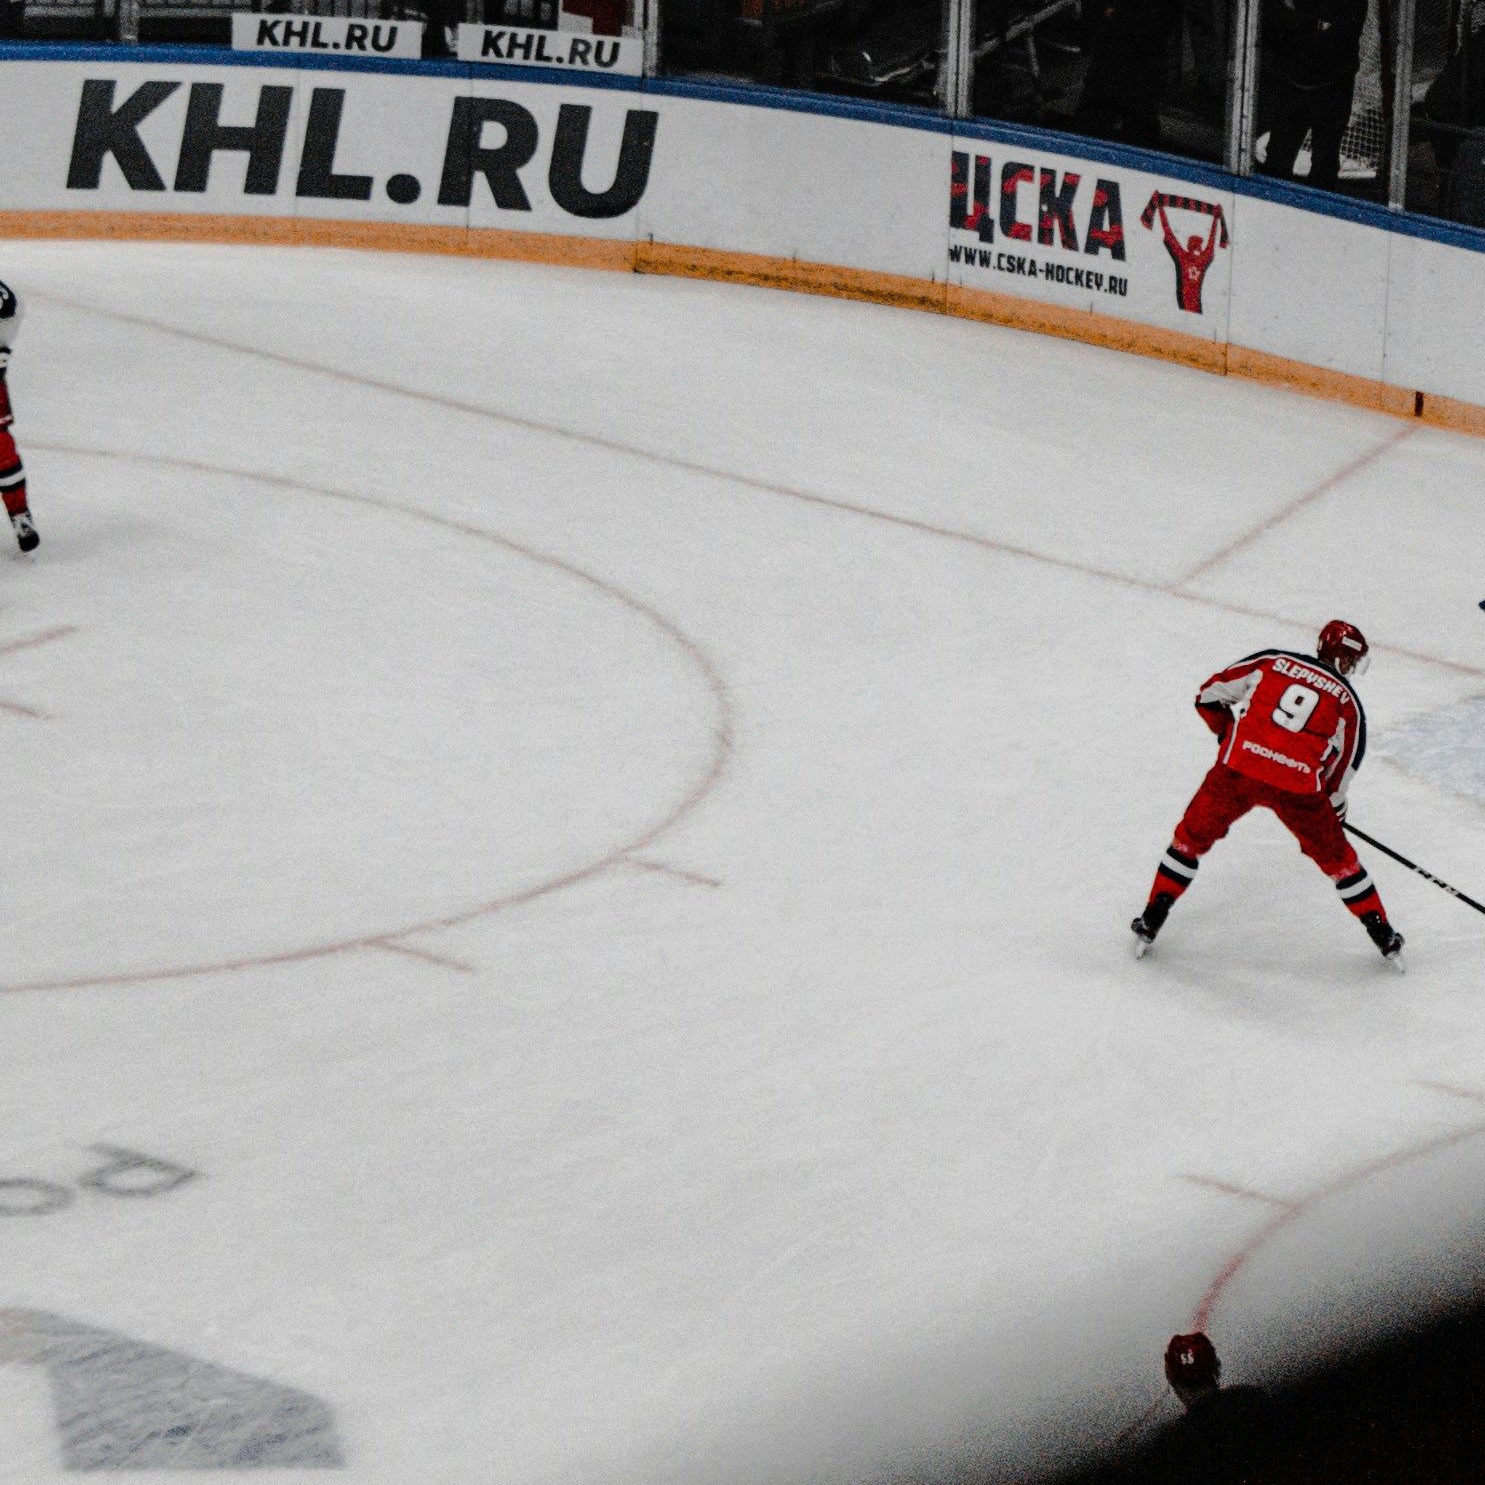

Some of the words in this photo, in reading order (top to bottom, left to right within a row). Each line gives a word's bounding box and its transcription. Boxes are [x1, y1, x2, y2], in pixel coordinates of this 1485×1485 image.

[256, 19, 398, 53] KHL.RU
[480, 30, 620, 69] KHL.RU
[66, 78, 660, 219] KHL.RU
[949, 150, 1127, 262] ЦСКА
[948, 243, 1129, 297] WWW.CSKA-HOCKEY.RU
[1272, 683, 1320, 733] 9
